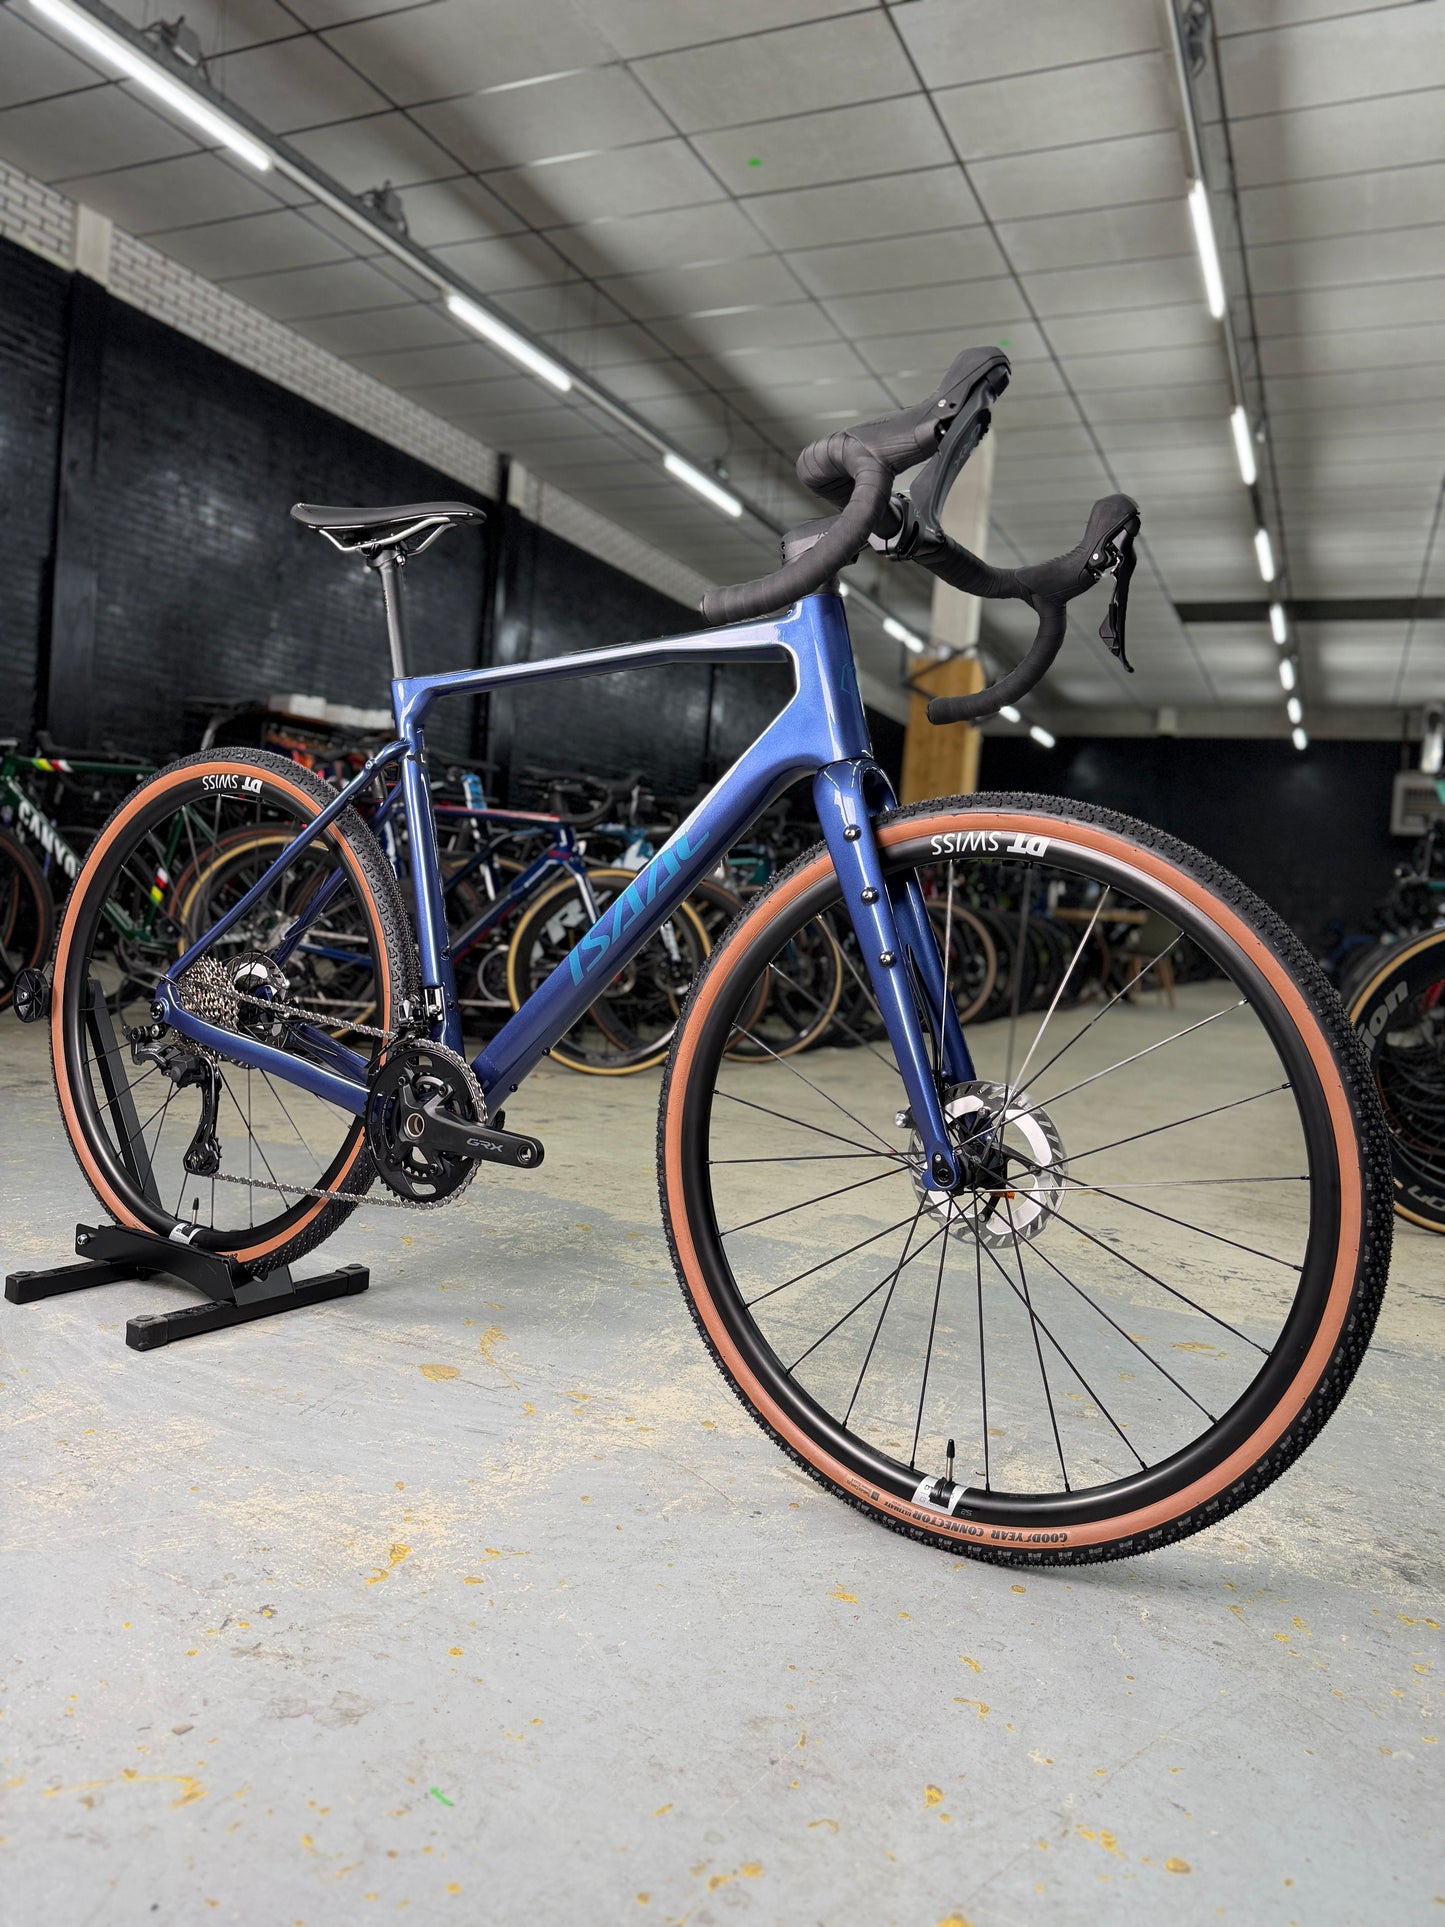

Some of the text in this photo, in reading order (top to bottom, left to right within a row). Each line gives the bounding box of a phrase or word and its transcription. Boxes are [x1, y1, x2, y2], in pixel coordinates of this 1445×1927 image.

[202, 774, 263, 794] DT SWISS
[18, 800, 81, 880] CANYO
[930, 831, 1051, 857] DT SWISS
[567, 828, 710, 987] ISAAC
[466, 1137, 504, 1153] GRX
[883, 1500, 912, 1517] ULTIMATE
[912, 1509, 984, 1537] CONNECTOR
